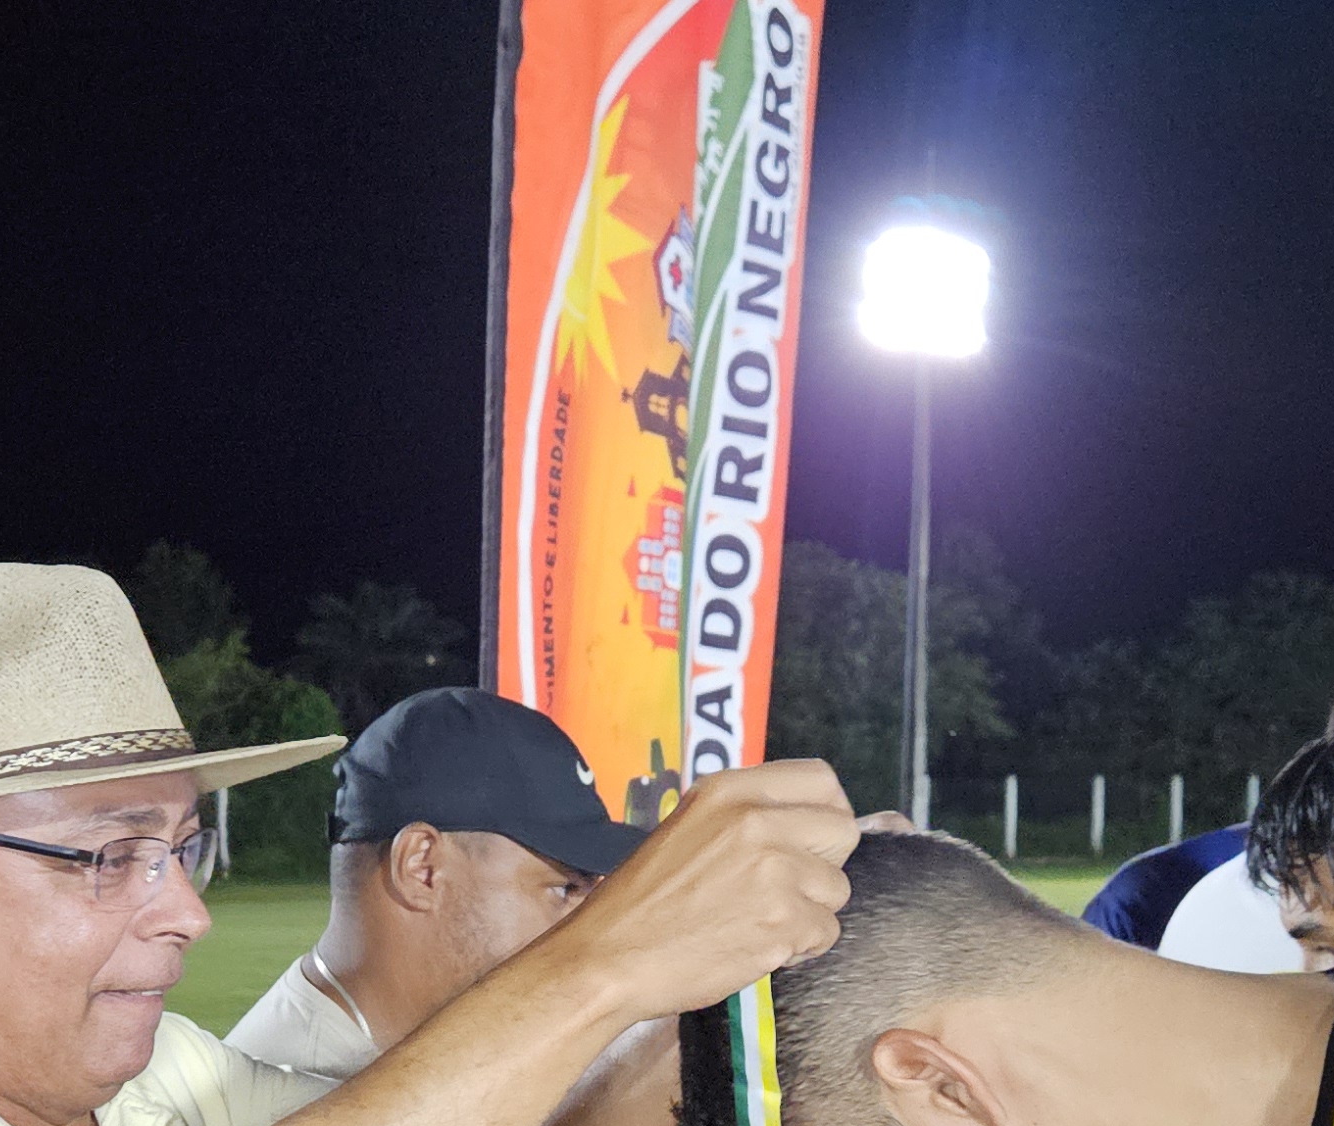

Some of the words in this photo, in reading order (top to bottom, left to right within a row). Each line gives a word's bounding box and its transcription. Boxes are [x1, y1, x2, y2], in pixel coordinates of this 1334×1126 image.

[737, 8, 795, 321] NEGRO
[546, 387, 571, 545] LIBERDADE
[714, 350, 772, 504] RIO
[700, 534, 750, 652] DO
